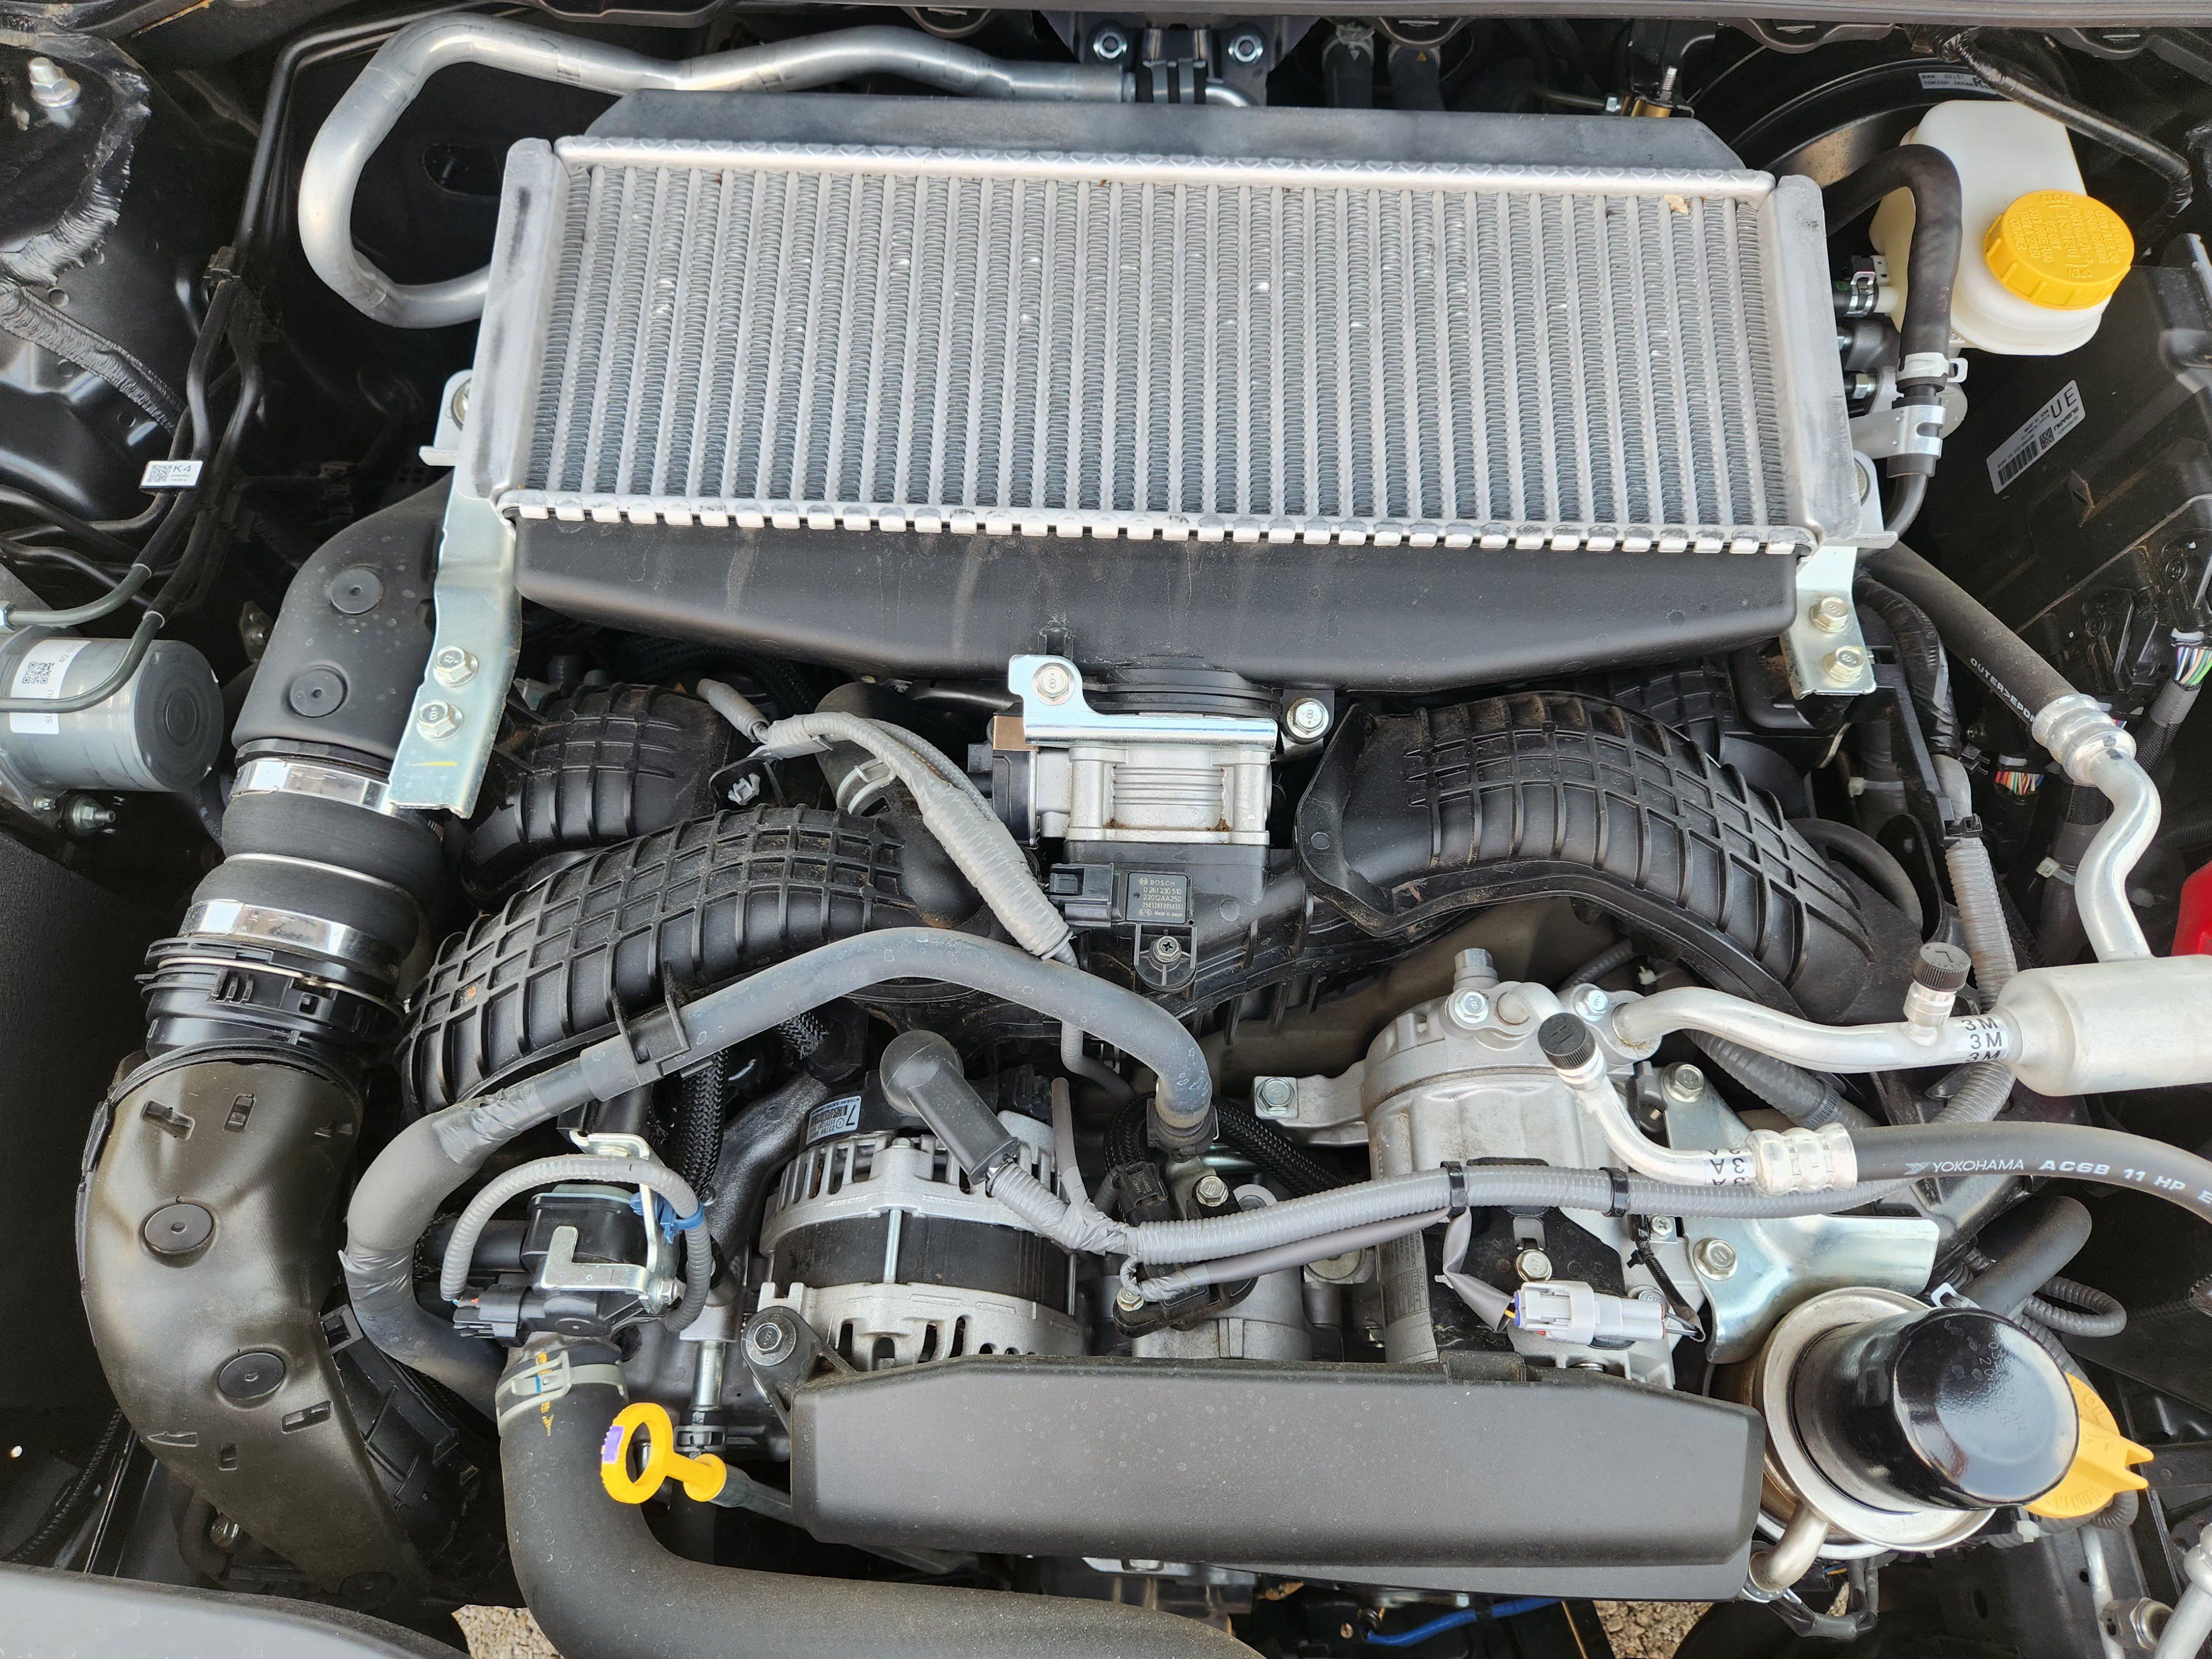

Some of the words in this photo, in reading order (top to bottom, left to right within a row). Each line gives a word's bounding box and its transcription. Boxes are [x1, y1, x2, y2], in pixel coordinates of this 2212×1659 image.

[2042, 195, 2073, 204] CLOSE
[2043, 221, 2057, 233] USE
[2083, 210, 2099, 231] BEFORE
[2008, 218, 2027, 250] CONTAINER
[2017, 211, 2032, 228] FROM
[2025, 236, 2041, 257] SEALED
[2033, 225, 2048, 244] BRAKE
[2048, 234, 2062, 249] ONLY
[2094, 210, 2110, 228] CLEAN
[2107, 251, 2121, 263] CAP
[2039, 245, 2054, 262] FLUID
[2090, 233, 2109, 263] REMOVING
[2069, 269, 2093, 278] OPEN
[1933, 1159, 2024, 1173] YOKOHAMA
[2124, 1168, 2146, 1182] 11
[2153, 1175, 2187, 1191] HP
